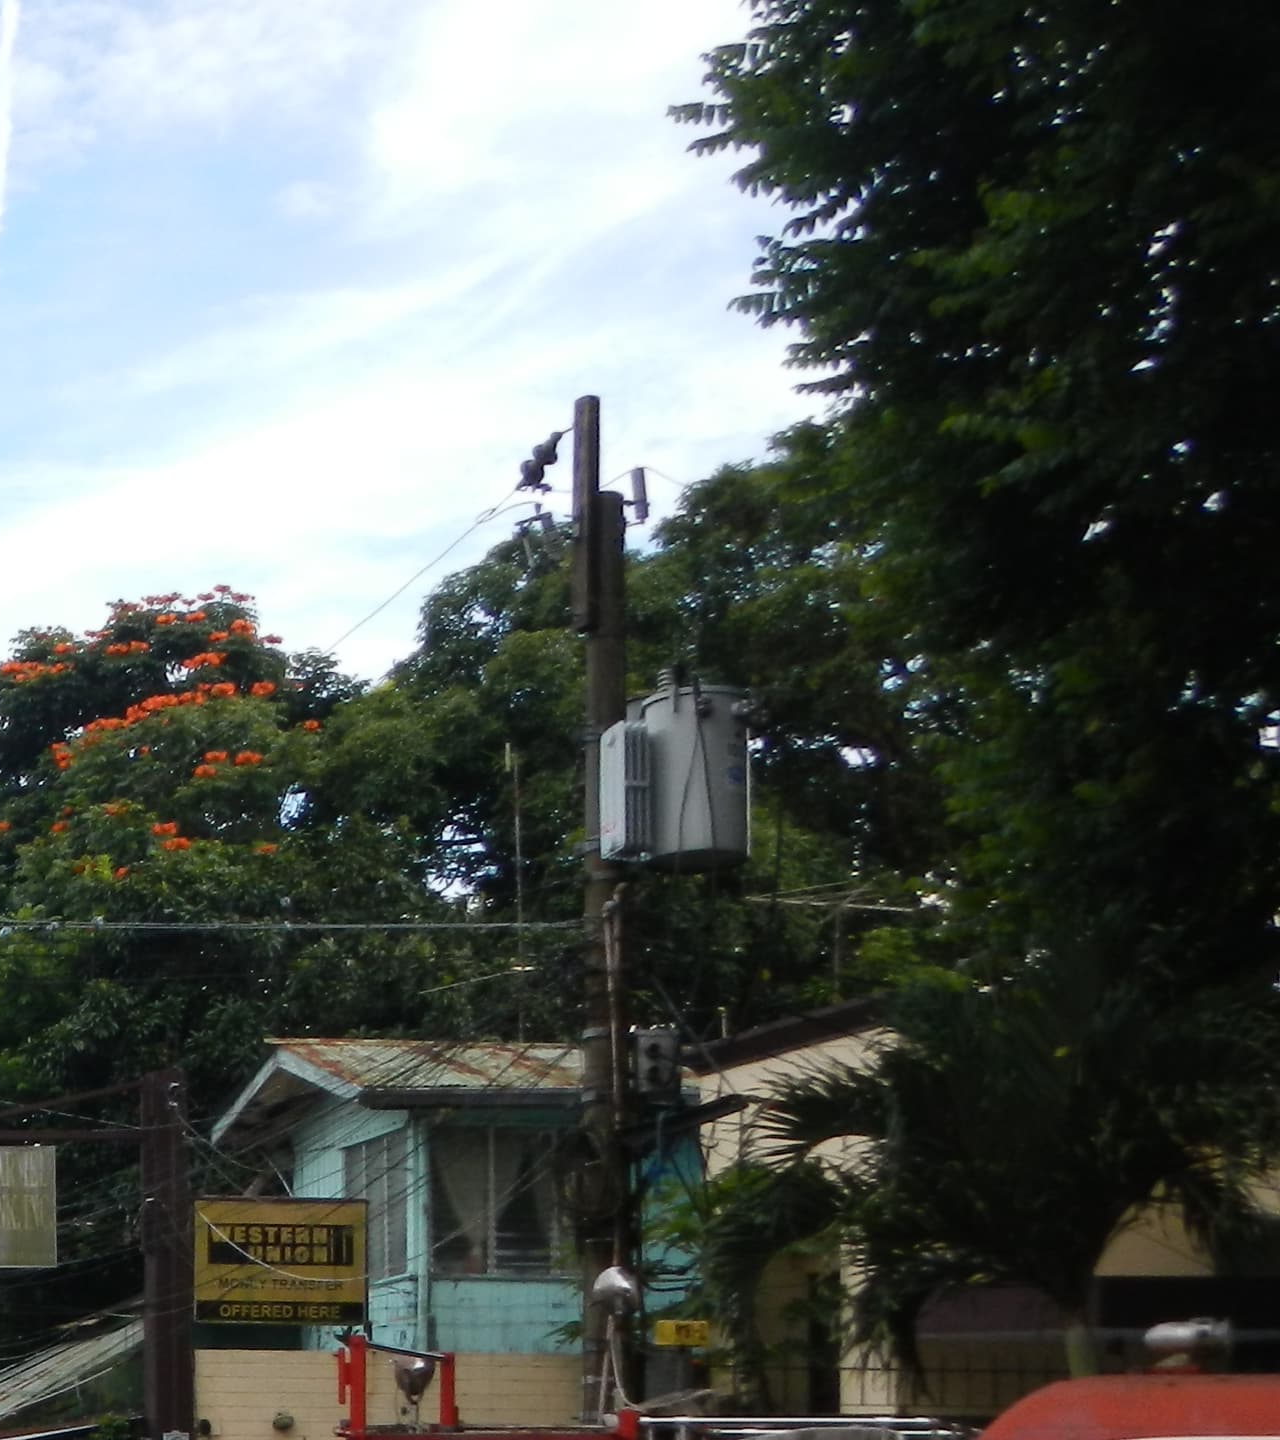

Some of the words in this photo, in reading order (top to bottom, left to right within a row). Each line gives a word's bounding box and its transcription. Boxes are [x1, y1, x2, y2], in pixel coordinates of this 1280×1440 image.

[210, 1225, 328, 1244] WESTERN
[249, 1246, 328, 1264] UNION
[217, 1278, 266, 1291] MONEY
[271, 1279, 345, 1291] TRANSFER
[219, 1304, 293, 1318] OFFERED
[297, 1306, 340, 1319] HERE
